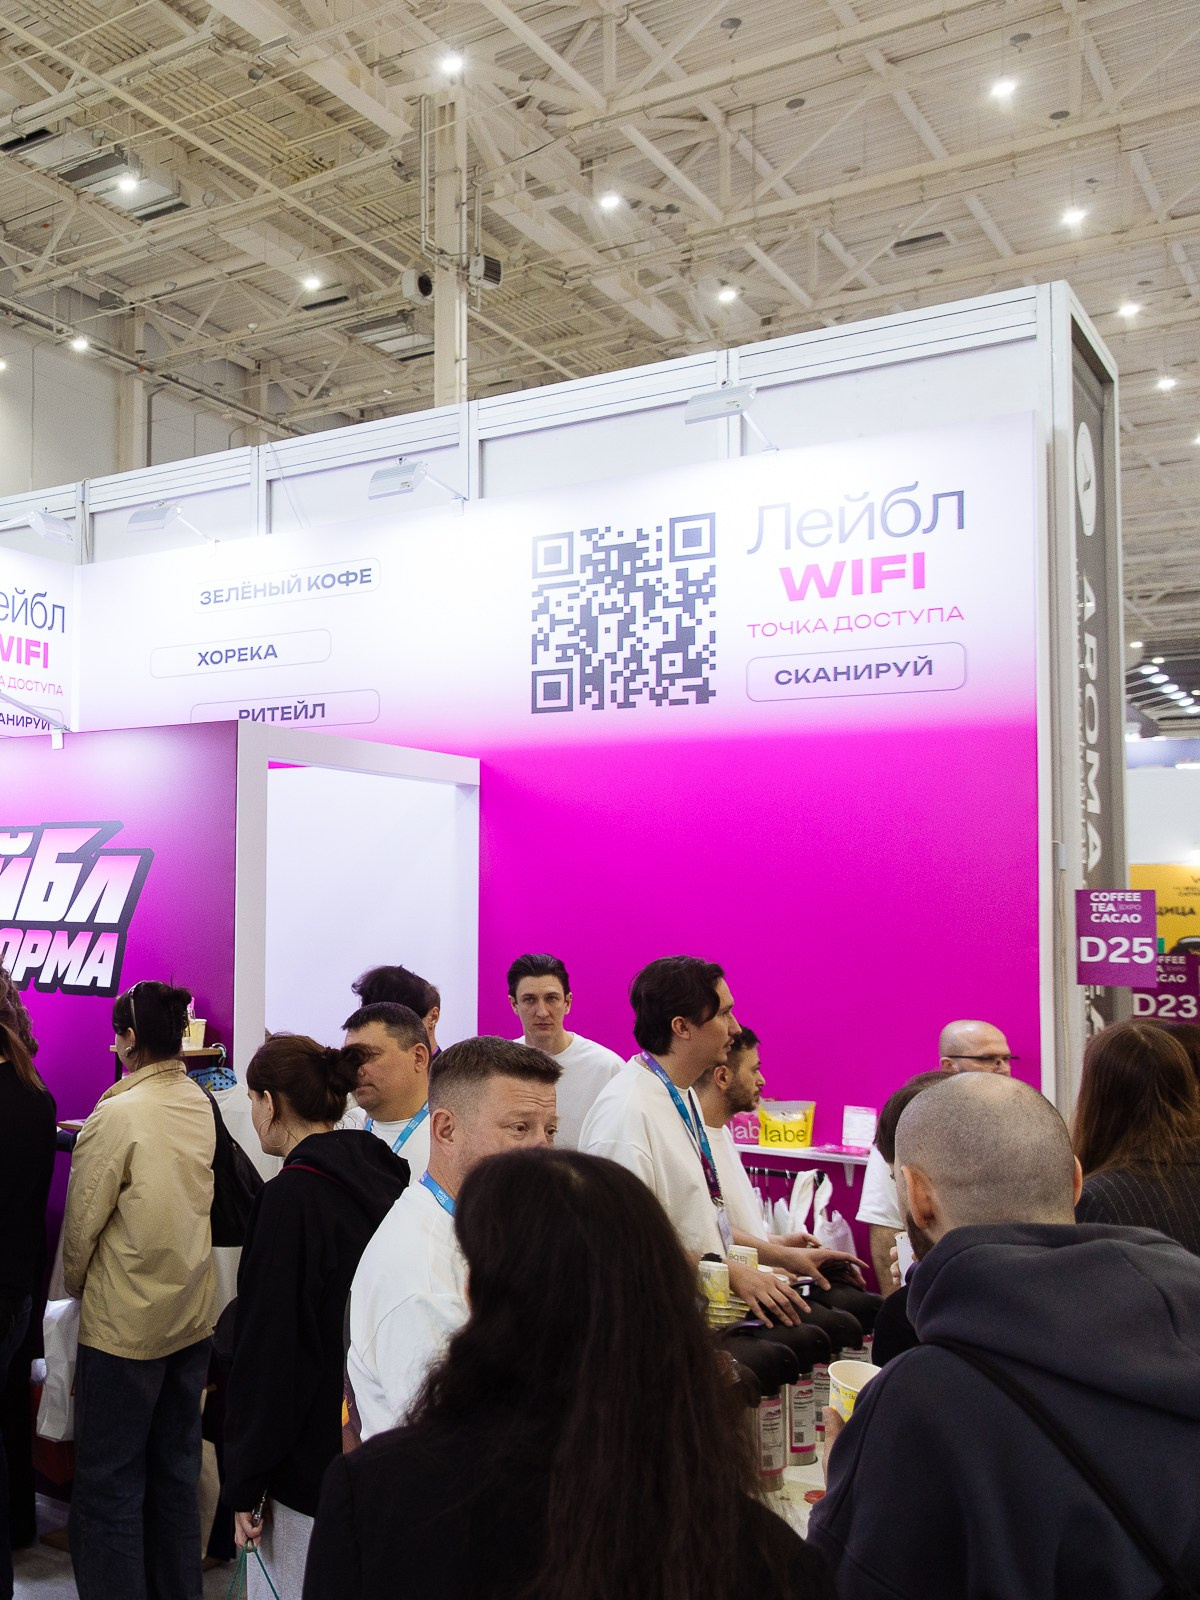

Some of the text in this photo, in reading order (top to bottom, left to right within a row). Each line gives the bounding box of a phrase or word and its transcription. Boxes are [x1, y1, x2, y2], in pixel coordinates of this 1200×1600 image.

[746, 481, 964, 555] Лейбл
[200, 568, 372, 605] ЗЕЛЁНЫЙ КОФЕ
[779, 552, 925, 602] WIFI
[747, 606, 965, 638] ТОЧКА ДОСТУПА
[197, 644, 278, 666] ХОРЕКА
[774, 655, 933, 685] СКАНИРУЙ
[7, 676, 64, 696] ДОСТУПА
[238, 700, 326, 723] РИТЕЙЛ
[1083, 568, 1101, 873] AROMA
[1089, 892, 1141, 902] COFFEE
[1090, 903, 1116, 912] TEA
[1090, 913, 1142, 924] CACAO
[1079, 936, 1155, 964] D25
[1156, 956, 1186, 965] FFEE
[1156, 973, 1187, 983] CAO
[1133, 993, 1198, 1019] D23
[730, 1120, 760, 1140] lab
